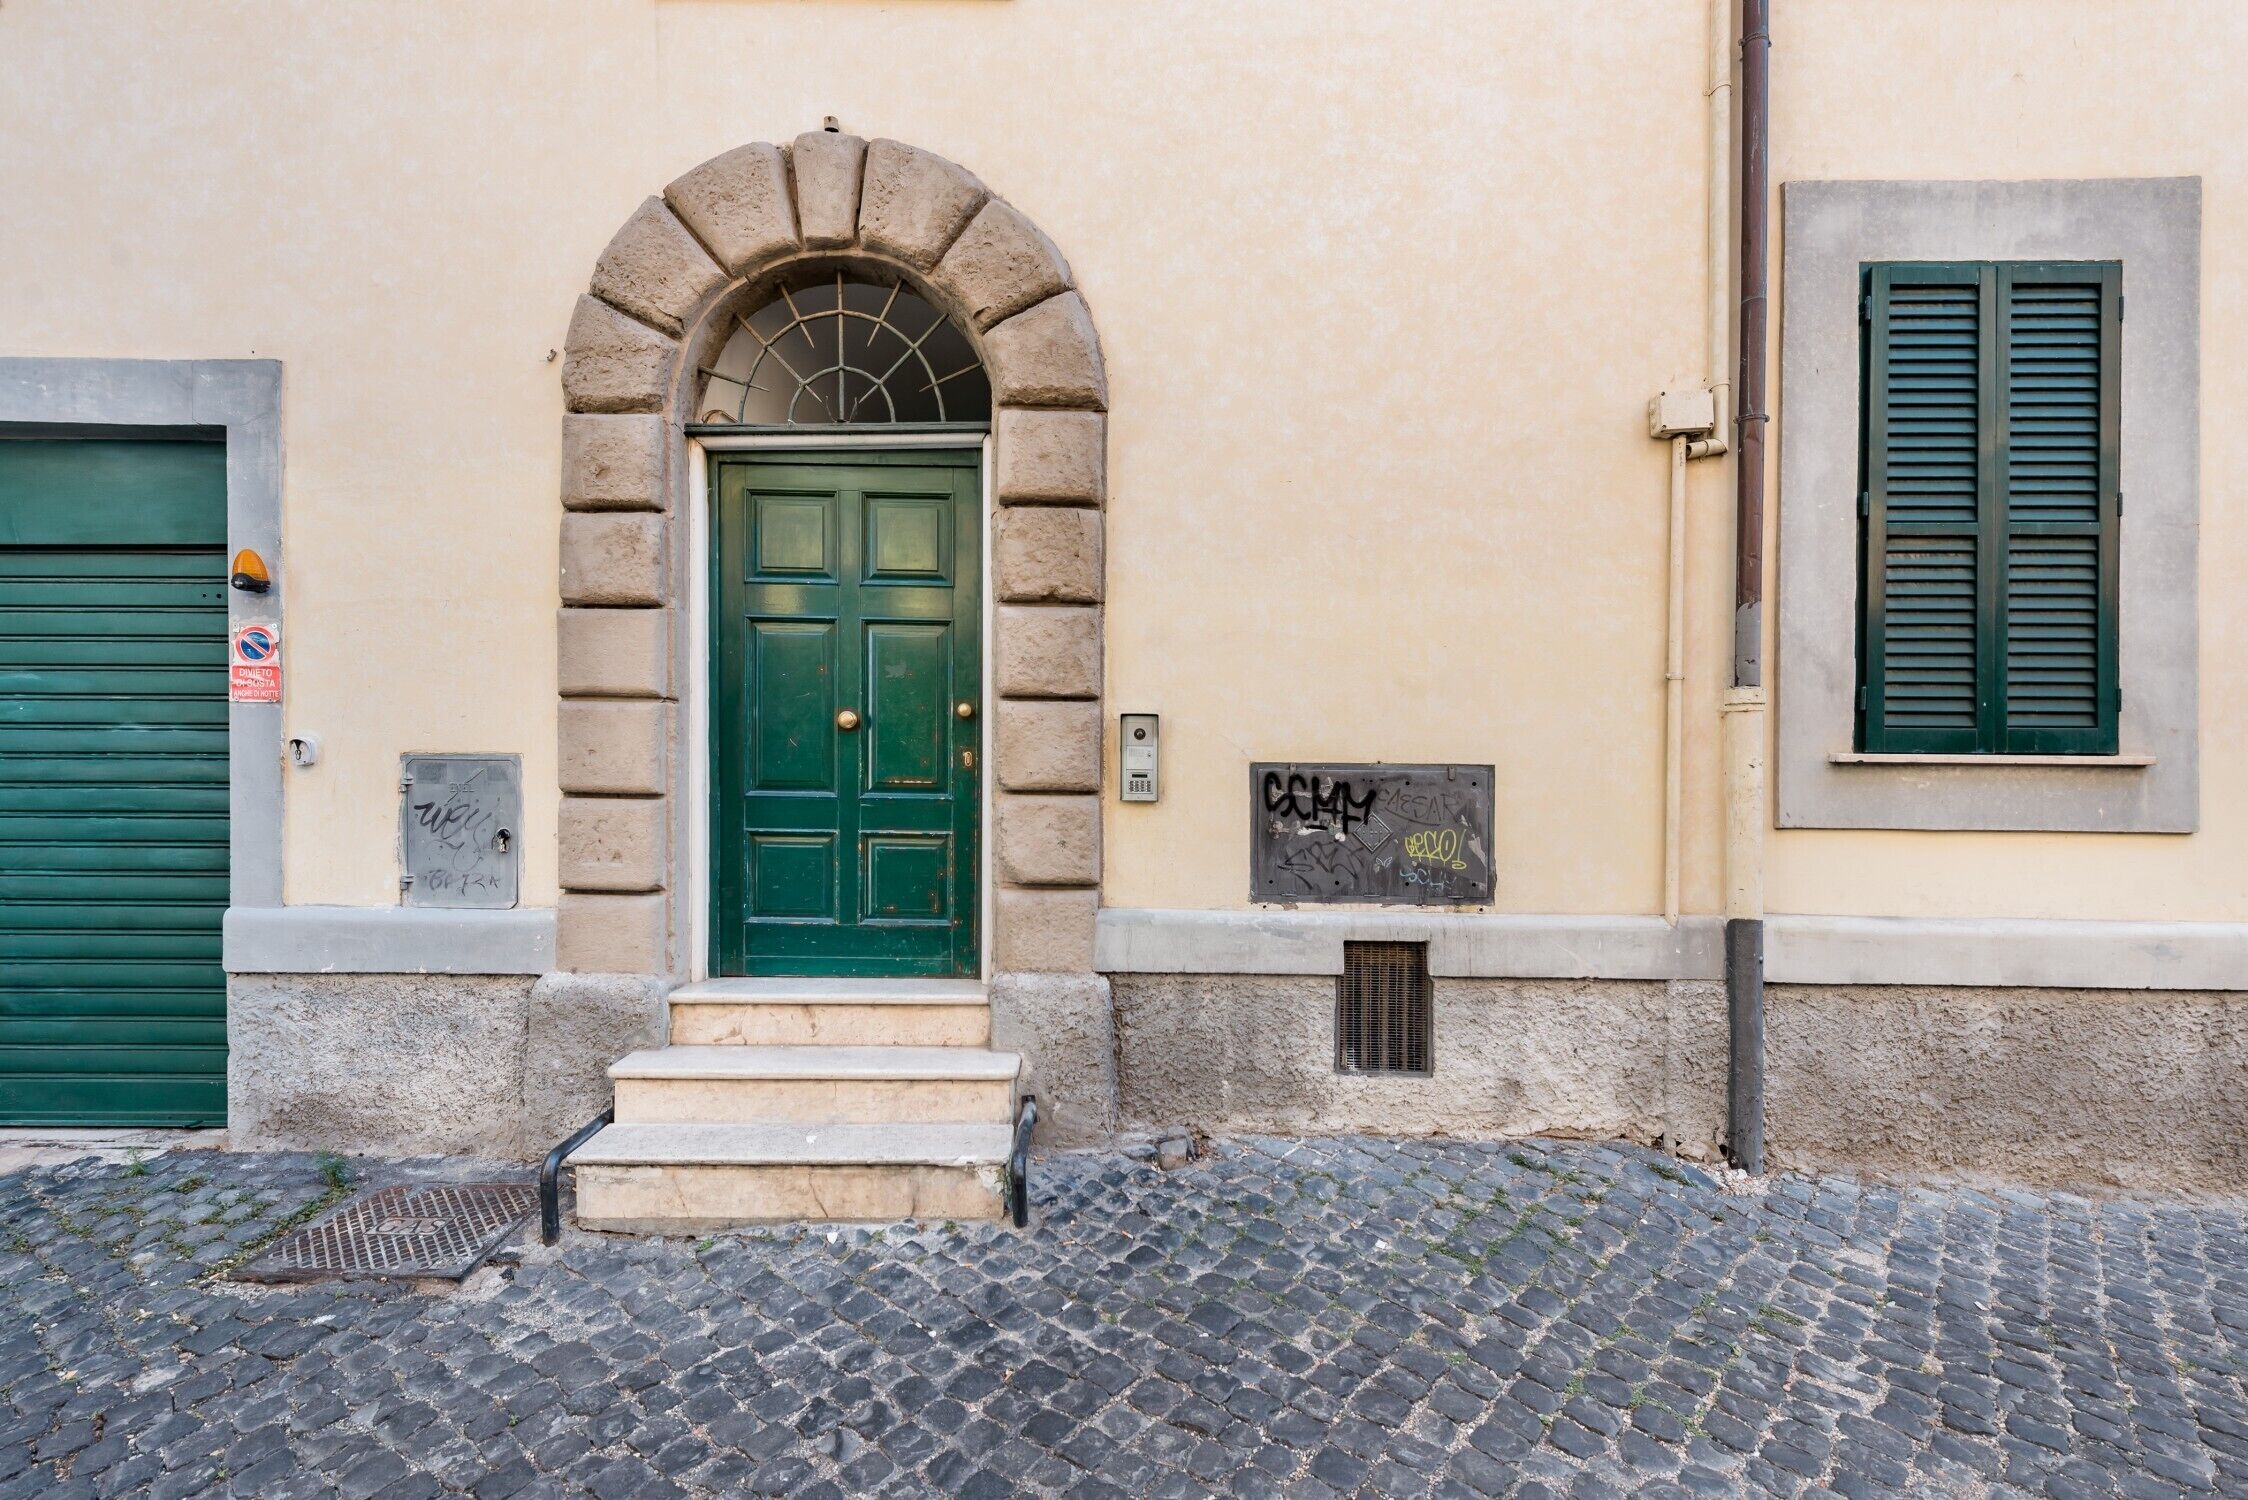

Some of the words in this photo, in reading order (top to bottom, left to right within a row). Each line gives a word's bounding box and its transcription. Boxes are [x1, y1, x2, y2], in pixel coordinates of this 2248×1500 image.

[240, 669, 272, 677] DIVIETO
[247, 679, 275, 687] SOSTA
[261, 690, 279, 698] NOTTE
[375, 1219, 447, 1234] GAS
